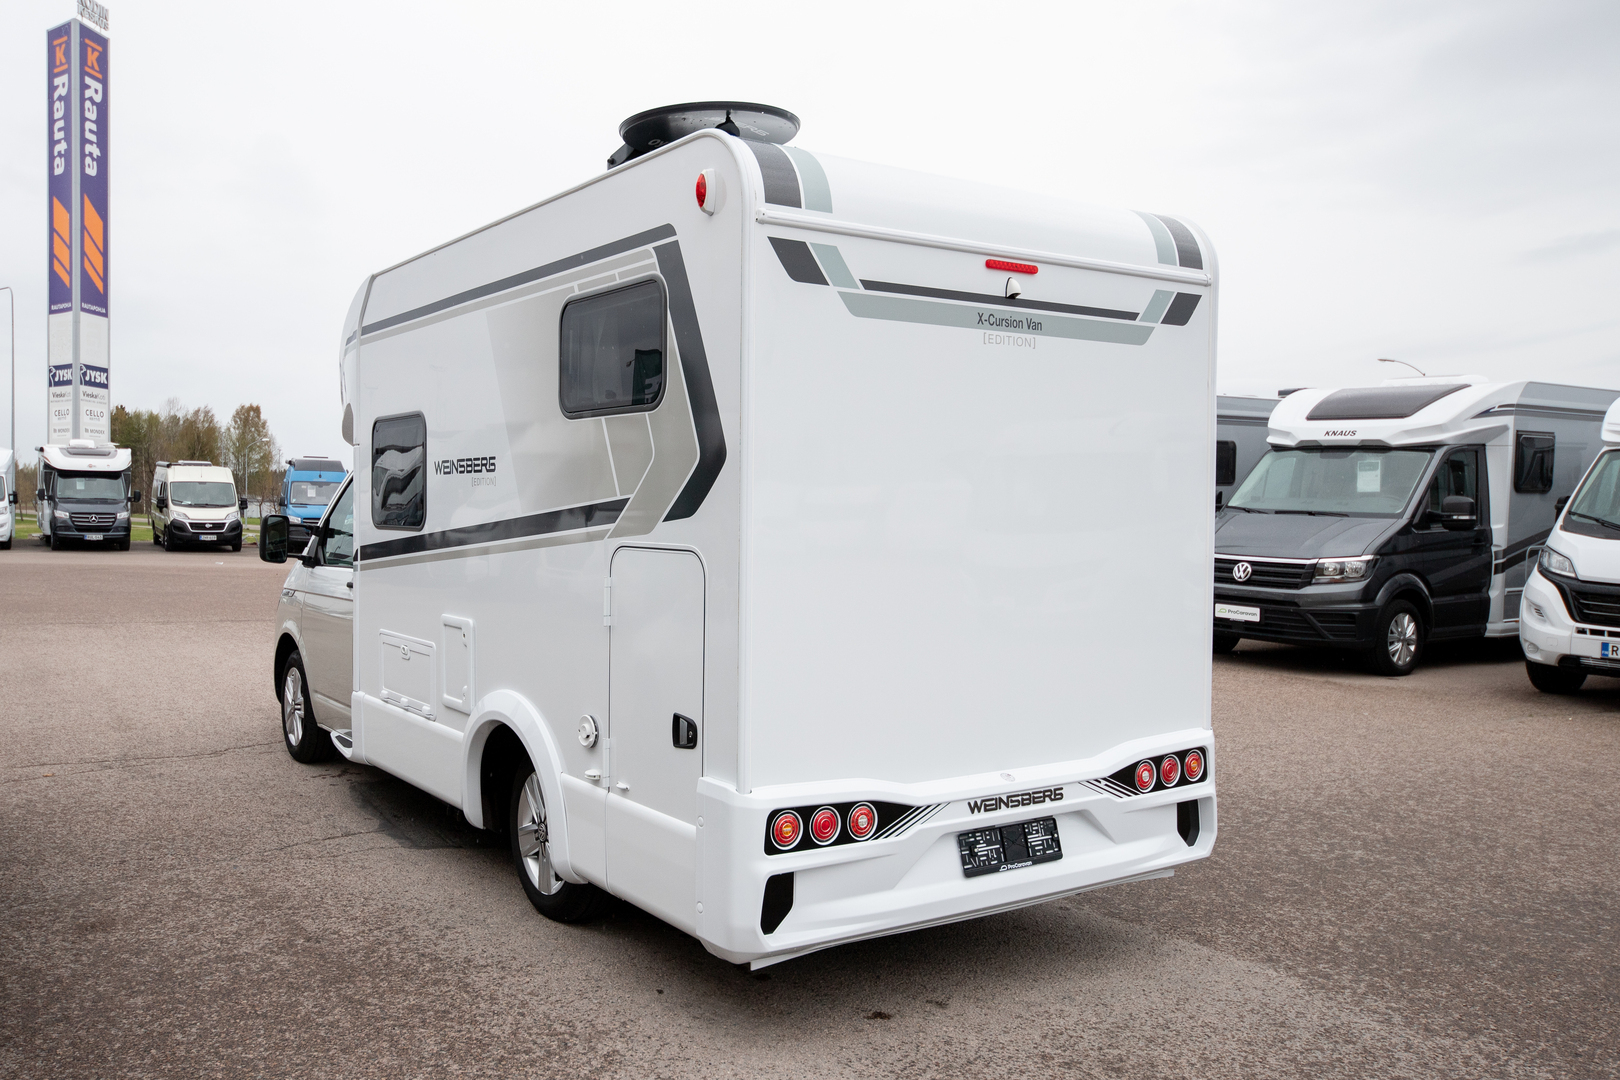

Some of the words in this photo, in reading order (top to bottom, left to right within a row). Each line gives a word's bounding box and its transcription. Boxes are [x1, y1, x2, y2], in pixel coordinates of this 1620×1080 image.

[977, 312, 1023, 329] X-Cursion
[1026, 318, 1042, 331] Van
[55, 368, 72, 382] JYSK
[85, 369, 107, 384] JYSK
[54, 408, 70, 417] CELLO
[85, 408, 105, 418] CELLO
[434, 456, 496, 475] WEINSBERG
[967, 787, 1064, 815] WEINSBERG
[1007, 861, 1033, 870] ProCaravan
